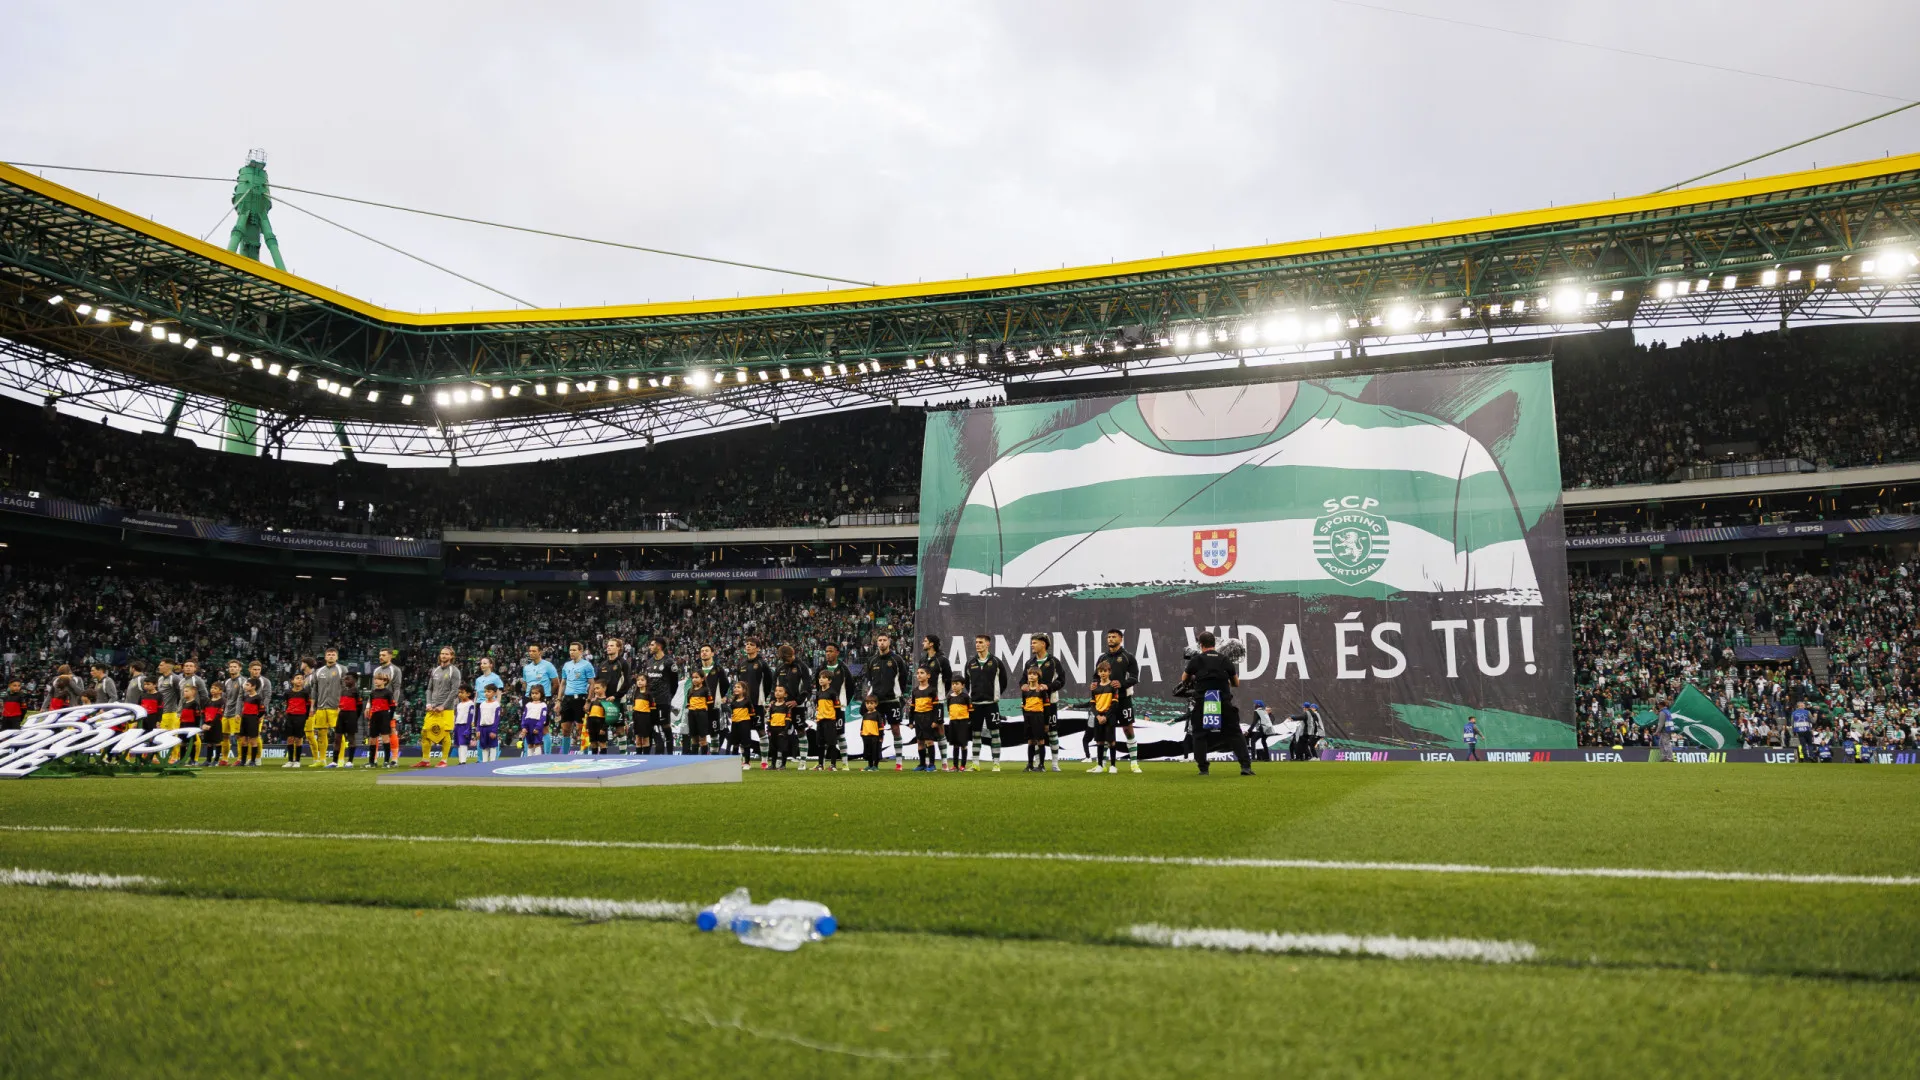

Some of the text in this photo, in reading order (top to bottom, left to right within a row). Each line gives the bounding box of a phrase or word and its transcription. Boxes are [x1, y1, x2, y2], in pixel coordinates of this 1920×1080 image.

[0, 498, 36, 509] EAGUE
[1323, 495, 1379, 512] SCP
[1320, 515, 1382, 533] SPORTING
[1794, 524, 1823, 534] PEPSI
[261, 534, 369, 549] UEFA CHAMPIONS LEAGUE
[1572, 536, 1627, 547] CHAMPIONS
[1630, 534, 1666, 544] LEAGUE
[1324, 561, 1380, 576] PORTUGAL
[691, 571, 731, 579] CHAMPIONS
[732, 570, 758, 578] LEAGUE
[948, 635, 968, 679] A
[1334, 611, 1407, 680] ÉS
[1431, 616, 1537, 679] TU!
[892, 708, 900, 718] 25
[1203, 715, 1220, 725] 035
[1335, 751, 1388, 761] #FOOTBALL
[1420, 752, 1455, 762] UEFA
[1486, 751, 1551, 762] WELCOME ALL
[1585, 752, 1623, 762] UEFA
[1764, 752, 1795, 763] UEF
